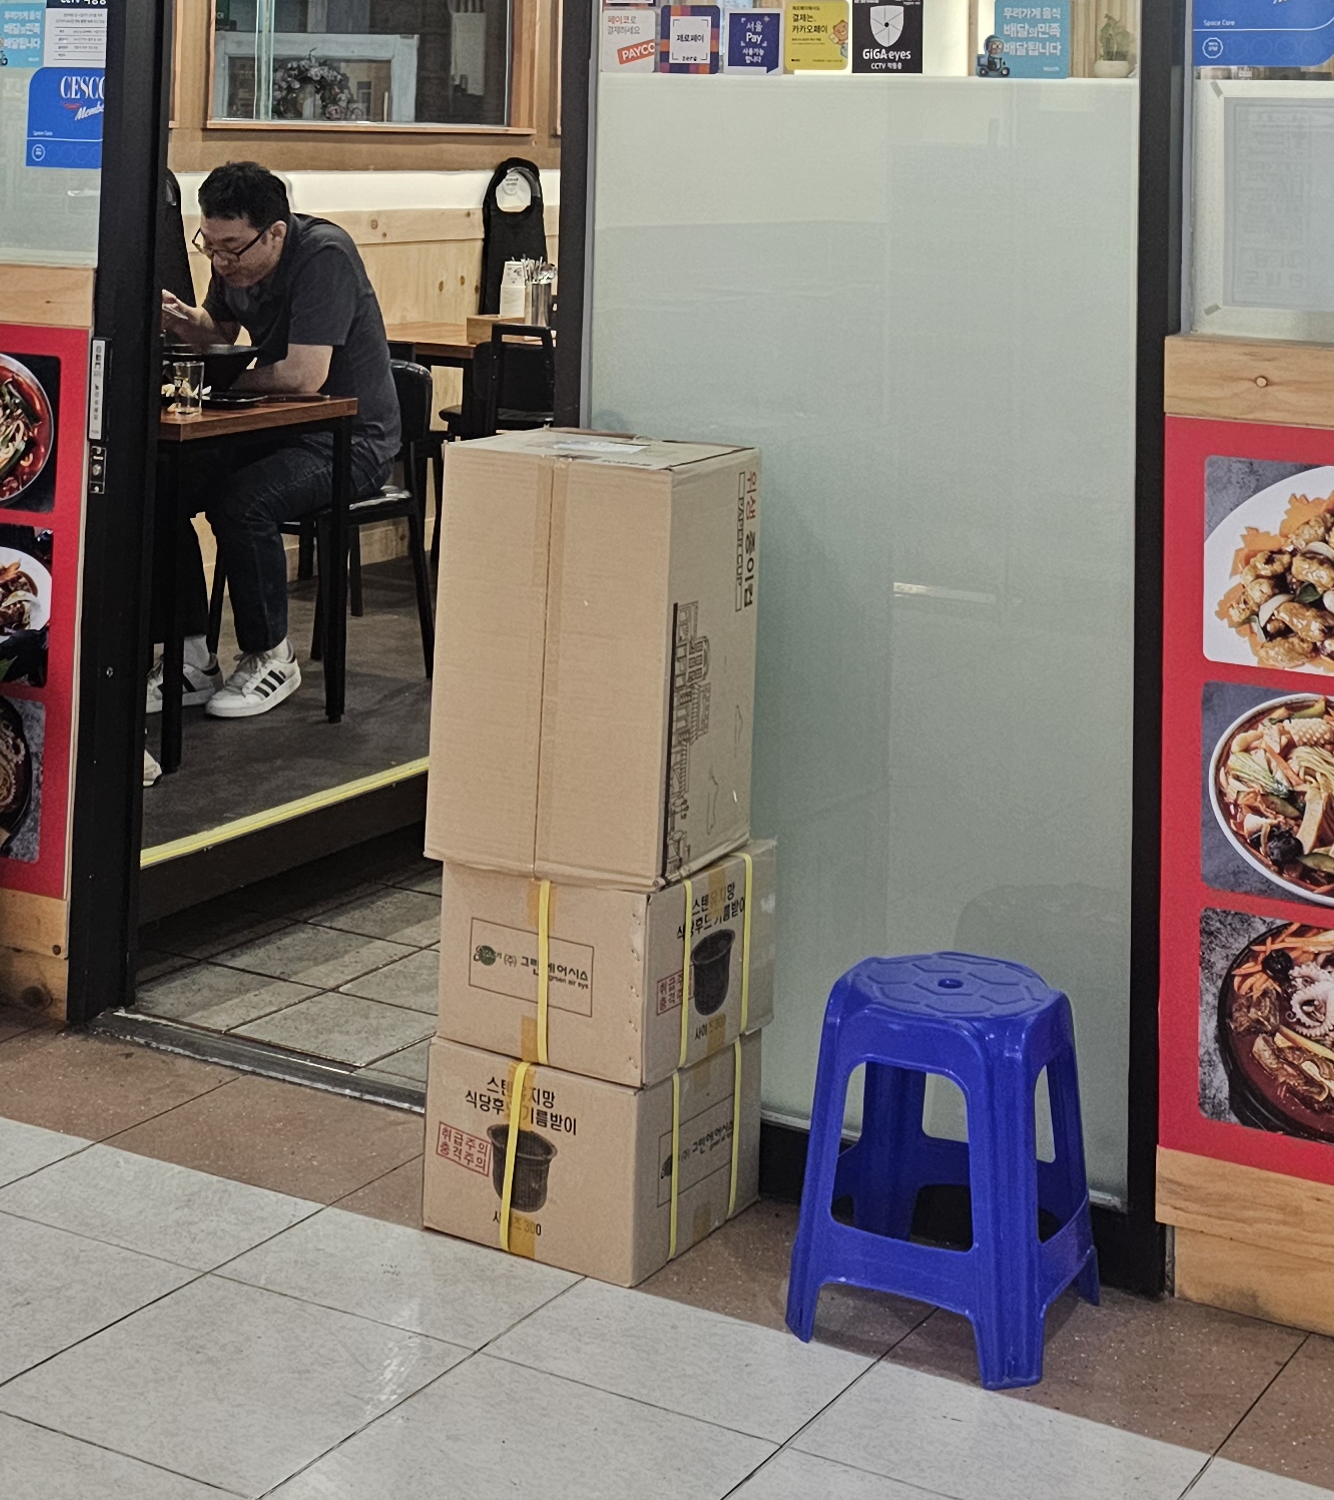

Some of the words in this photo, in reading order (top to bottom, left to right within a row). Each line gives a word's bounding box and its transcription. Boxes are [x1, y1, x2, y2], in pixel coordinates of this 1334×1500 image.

[1004, 7, 1041, 19] 우리가게
[1042, 7, 1061, 19] 음식
[746, 21, 763, 32] 서울
[792, 25, 827, 33] 카카오페이
[1003, 23, 1061, 38] 배달의민족
[676, 34, 704, 43] 제로페이
[746, 32, 762, 44] Pay
[622, 42, 655, 60] PAYCO
[1004, 41, 1061, 56] 배달됩니다
[747, 471, 758, 521] 위생
[744, 532, 756, 609] 종이컵
[465, 1090, 576, 1135] 식당후기름받이
[442, 1127, 489, 1158] 취급주의
[440, 1141, 487, 1172] 충격주의
